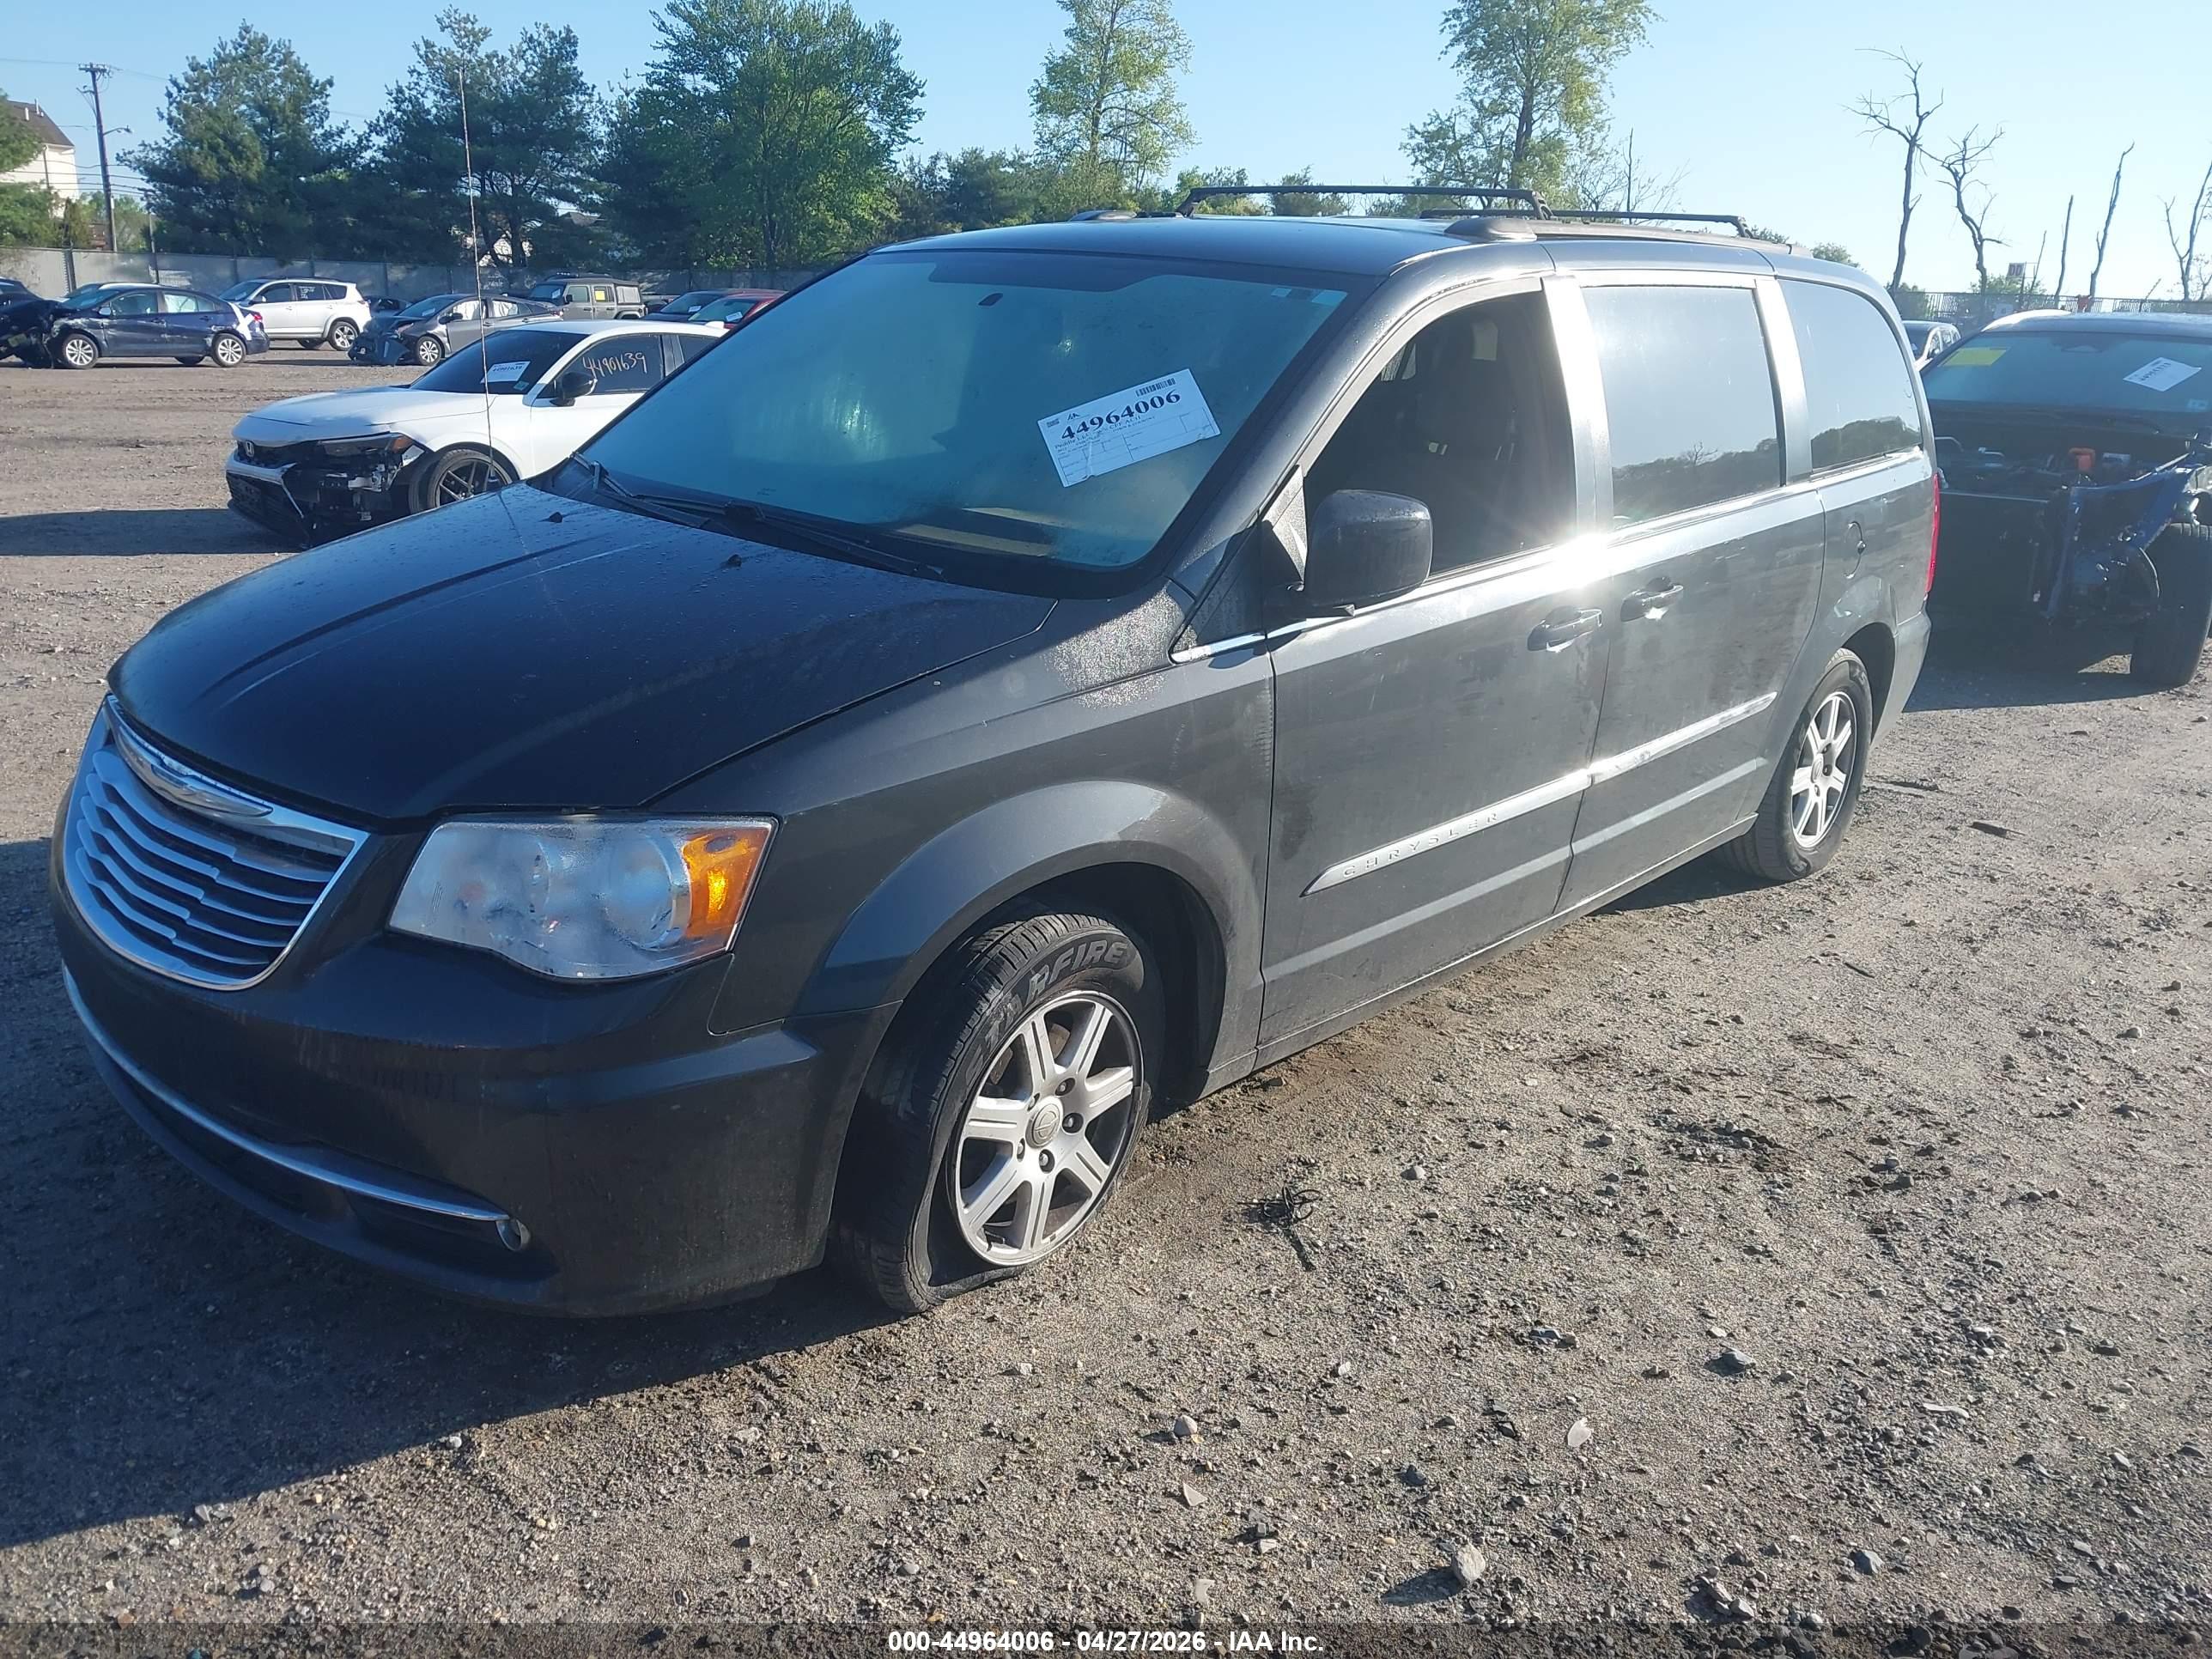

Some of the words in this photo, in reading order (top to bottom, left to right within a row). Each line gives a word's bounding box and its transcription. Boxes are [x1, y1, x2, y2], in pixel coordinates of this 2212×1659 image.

[582, 352, 648, 378] 44901639
[1060, 389, 1181, 440] 44964006
[1342, 812, 1498, 878] CHRYSLER
